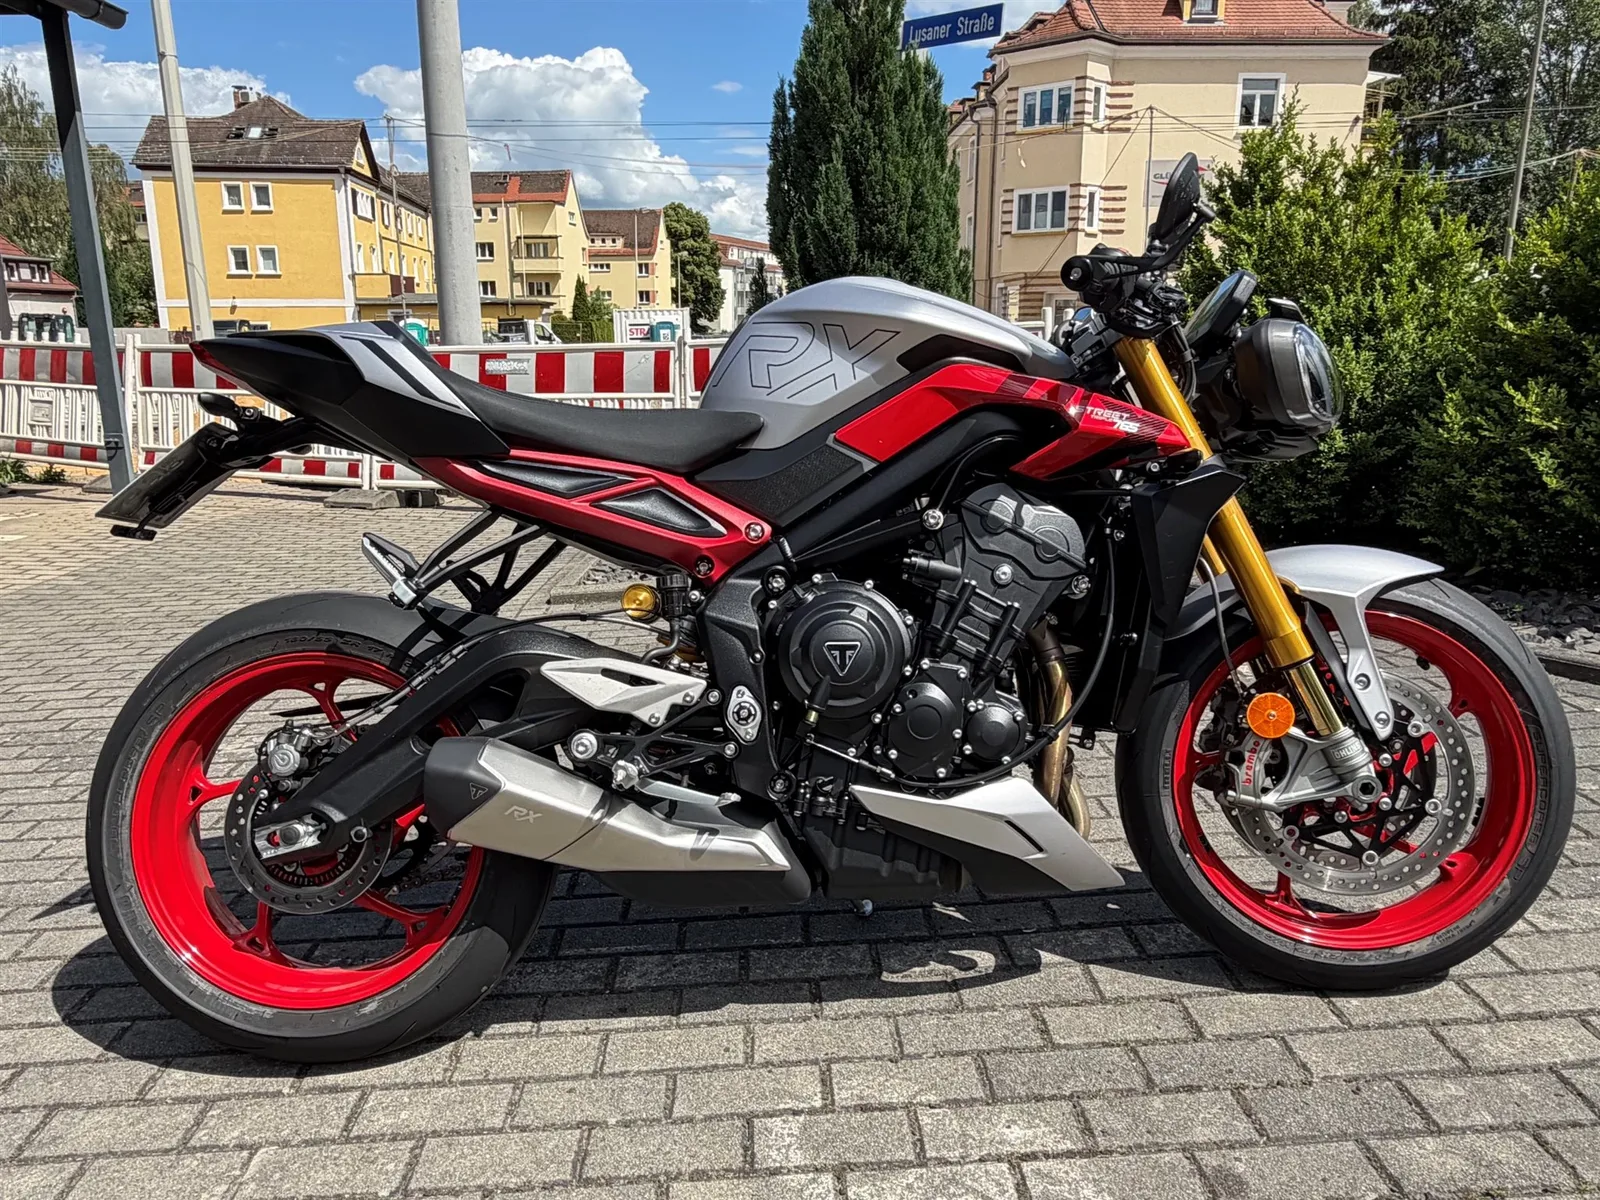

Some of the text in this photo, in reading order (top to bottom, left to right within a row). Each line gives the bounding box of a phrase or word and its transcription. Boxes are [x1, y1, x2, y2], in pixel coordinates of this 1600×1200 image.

[909, 12, 995, 43] Lusaner Straße
[712, 322, 901, 399] RX
[1075, 405, 1131, 421] STREET
[1113, 420, 1141, 433] 765
[1241, 740, 1260, 786] brembo
[504, 805, 543, 824] RX
